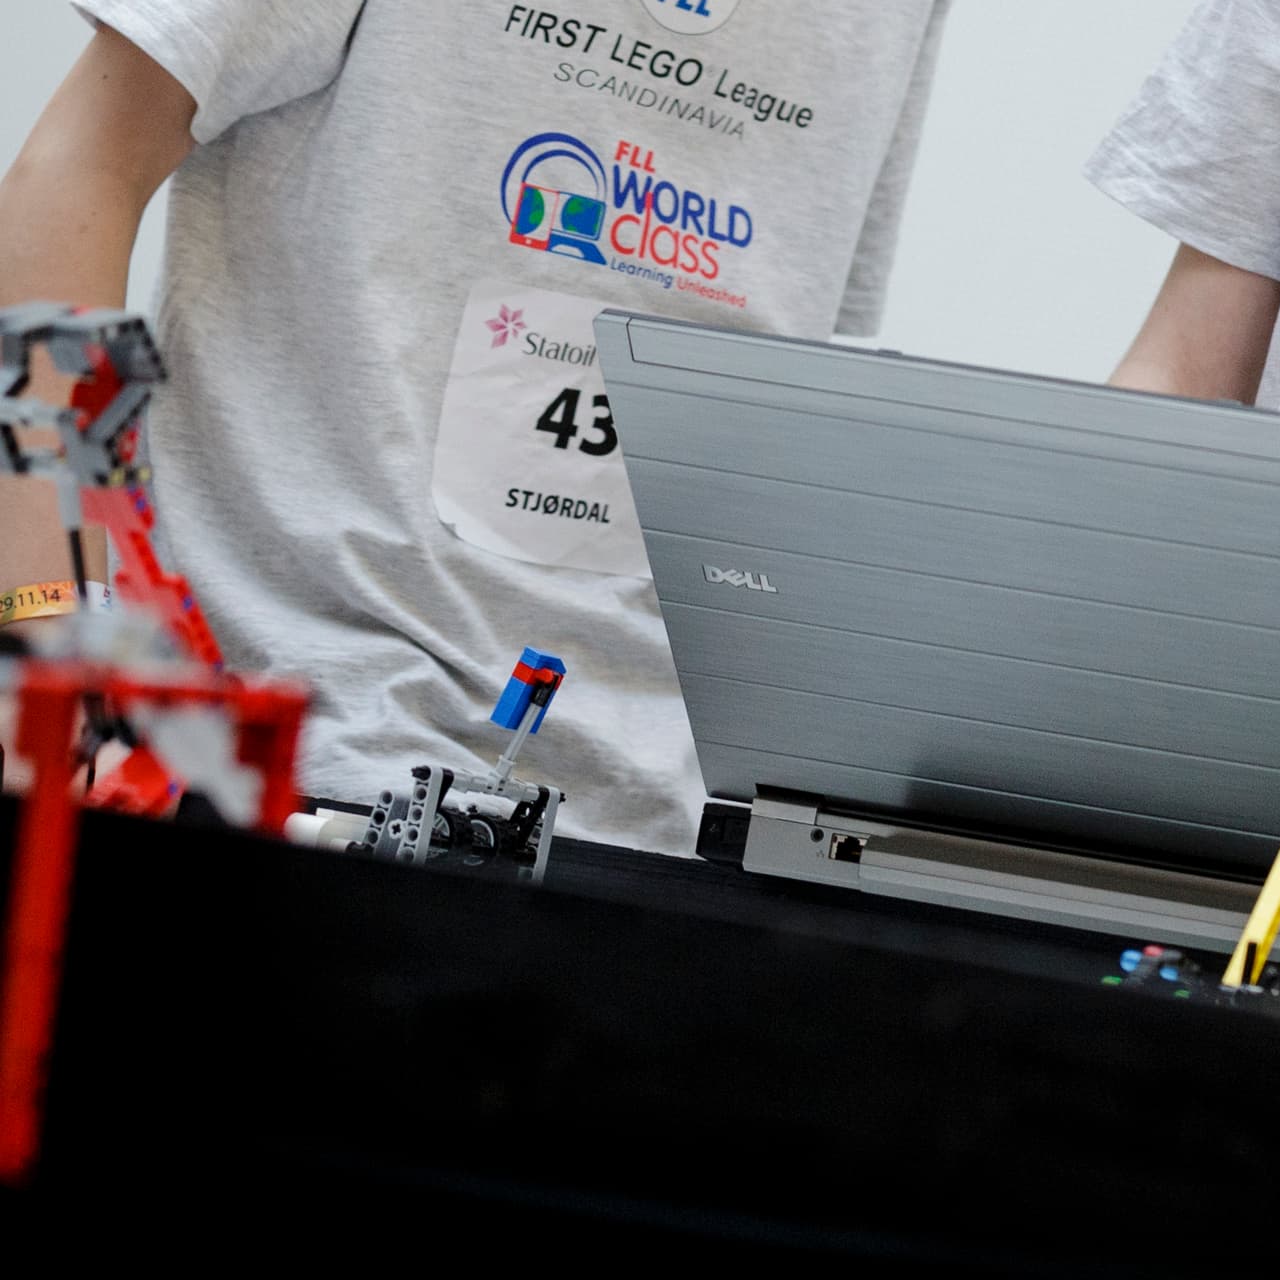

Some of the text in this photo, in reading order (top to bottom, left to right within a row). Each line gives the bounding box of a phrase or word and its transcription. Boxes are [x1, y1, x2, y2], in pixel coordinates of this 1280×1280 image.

[504, 5, 814, 128] FIRST LEGO League
[553, 62, 746, 140] SCANDINAVIA
[614, 139, 656, 173] FLL
[612, 163, 753, 248] WORLD
[609, 257, 748, 310] Learning Unleashed
[522, 331, 598, 368] Statoil
[535, 387, 619, 457] 43
[505, 488, 610, 524] STJØRDAL
[702, 565, 778, 593] DELL
